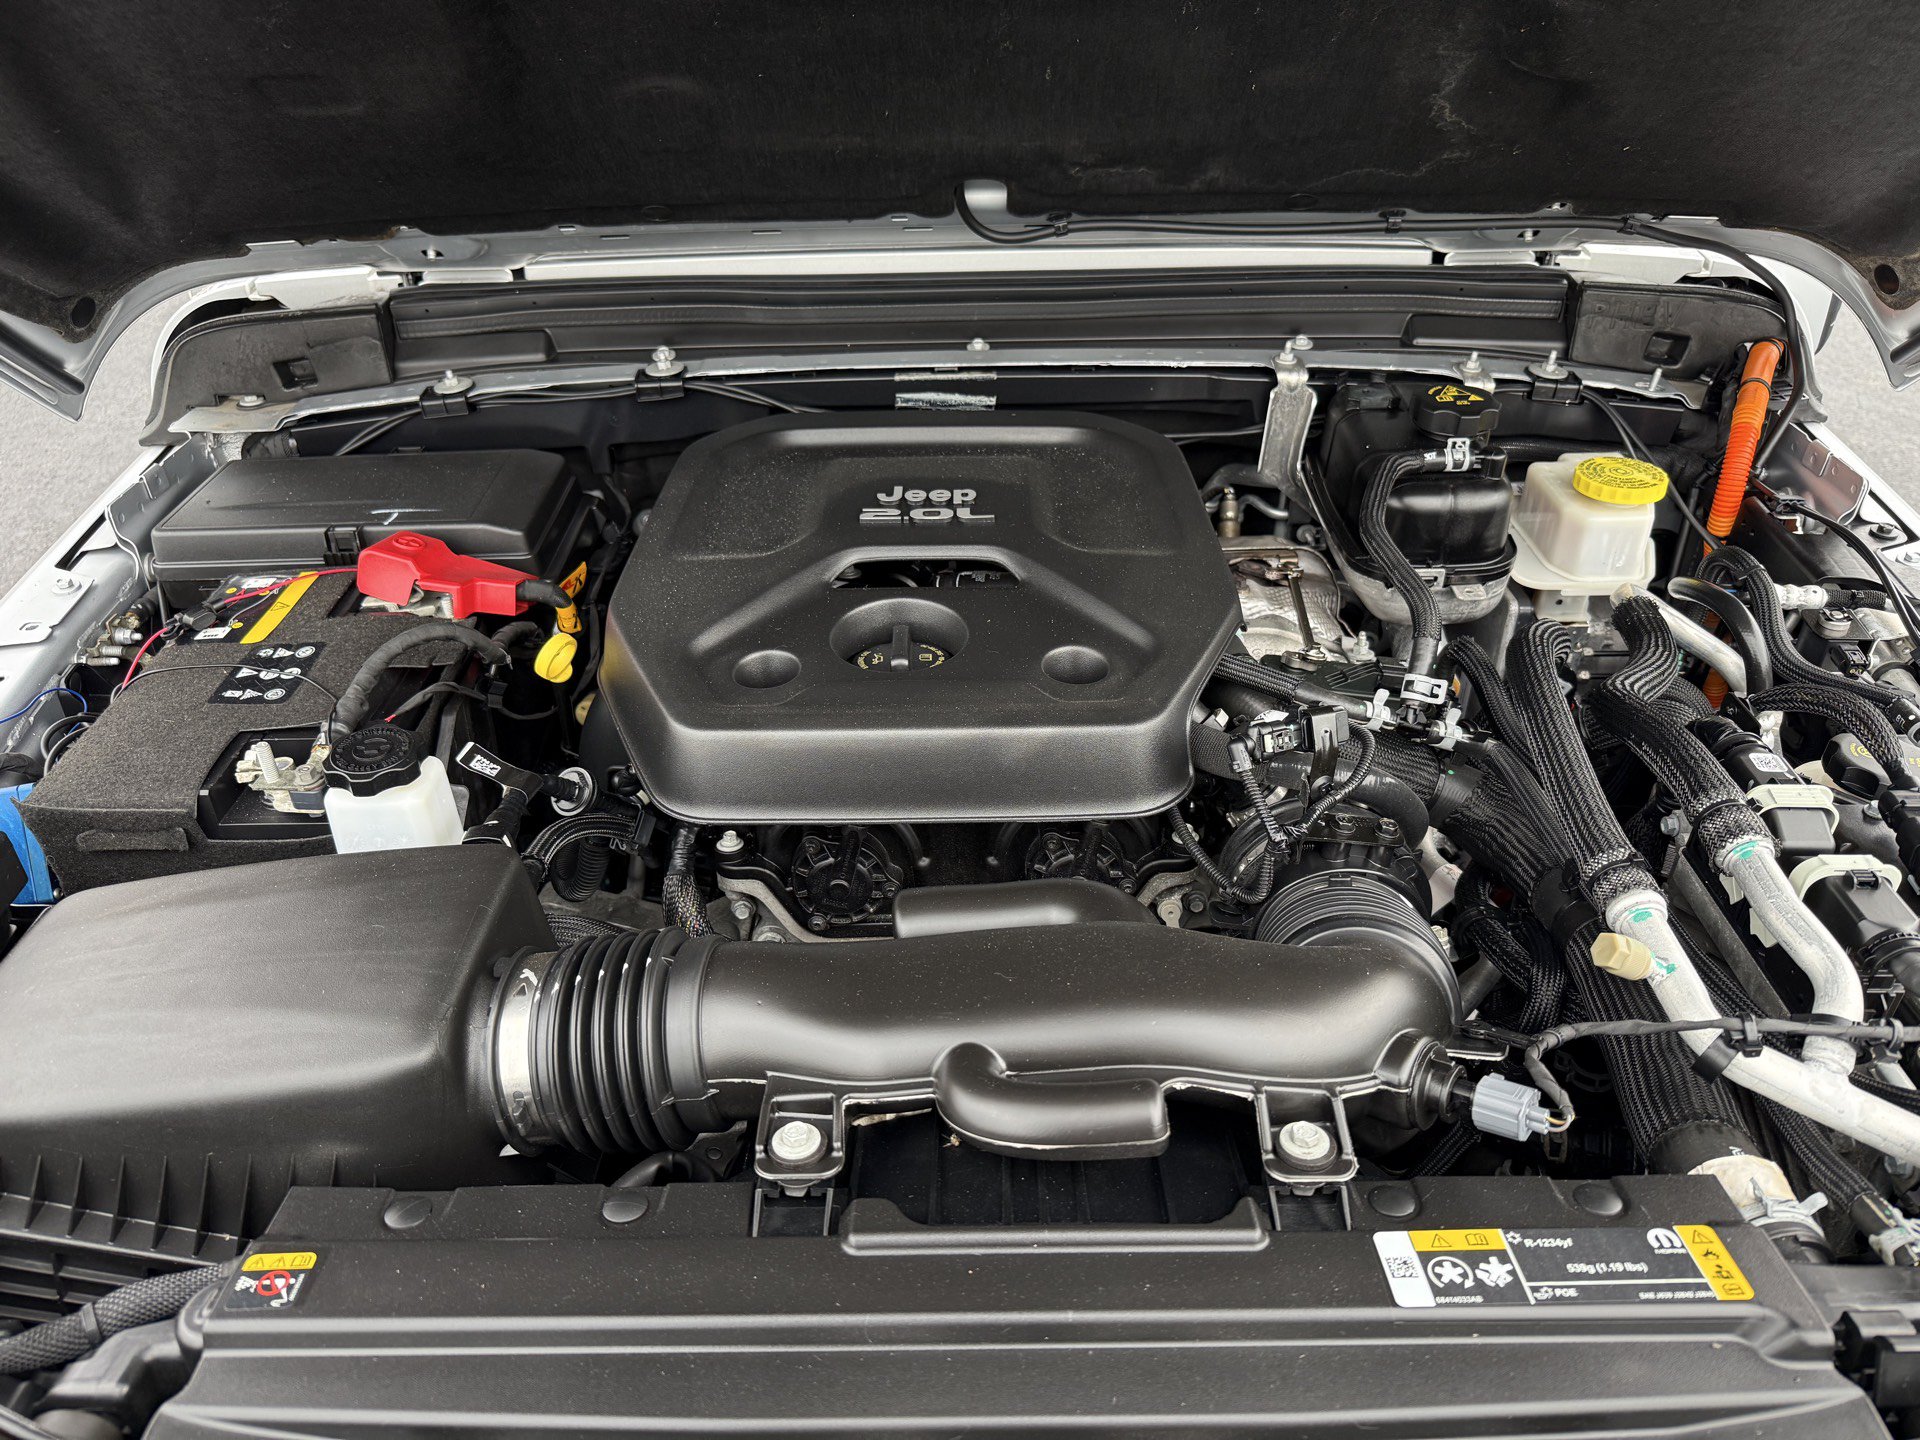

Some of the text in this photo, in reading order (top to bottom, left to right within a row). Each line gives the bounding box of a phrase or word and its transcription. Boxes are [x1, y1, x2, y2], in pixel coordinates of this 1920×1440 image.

[876, 485, 977, 505] Jeep
[859, 507, 995, 523] 2.0L
[1623, 1261, 1649, 1274] lbs)
